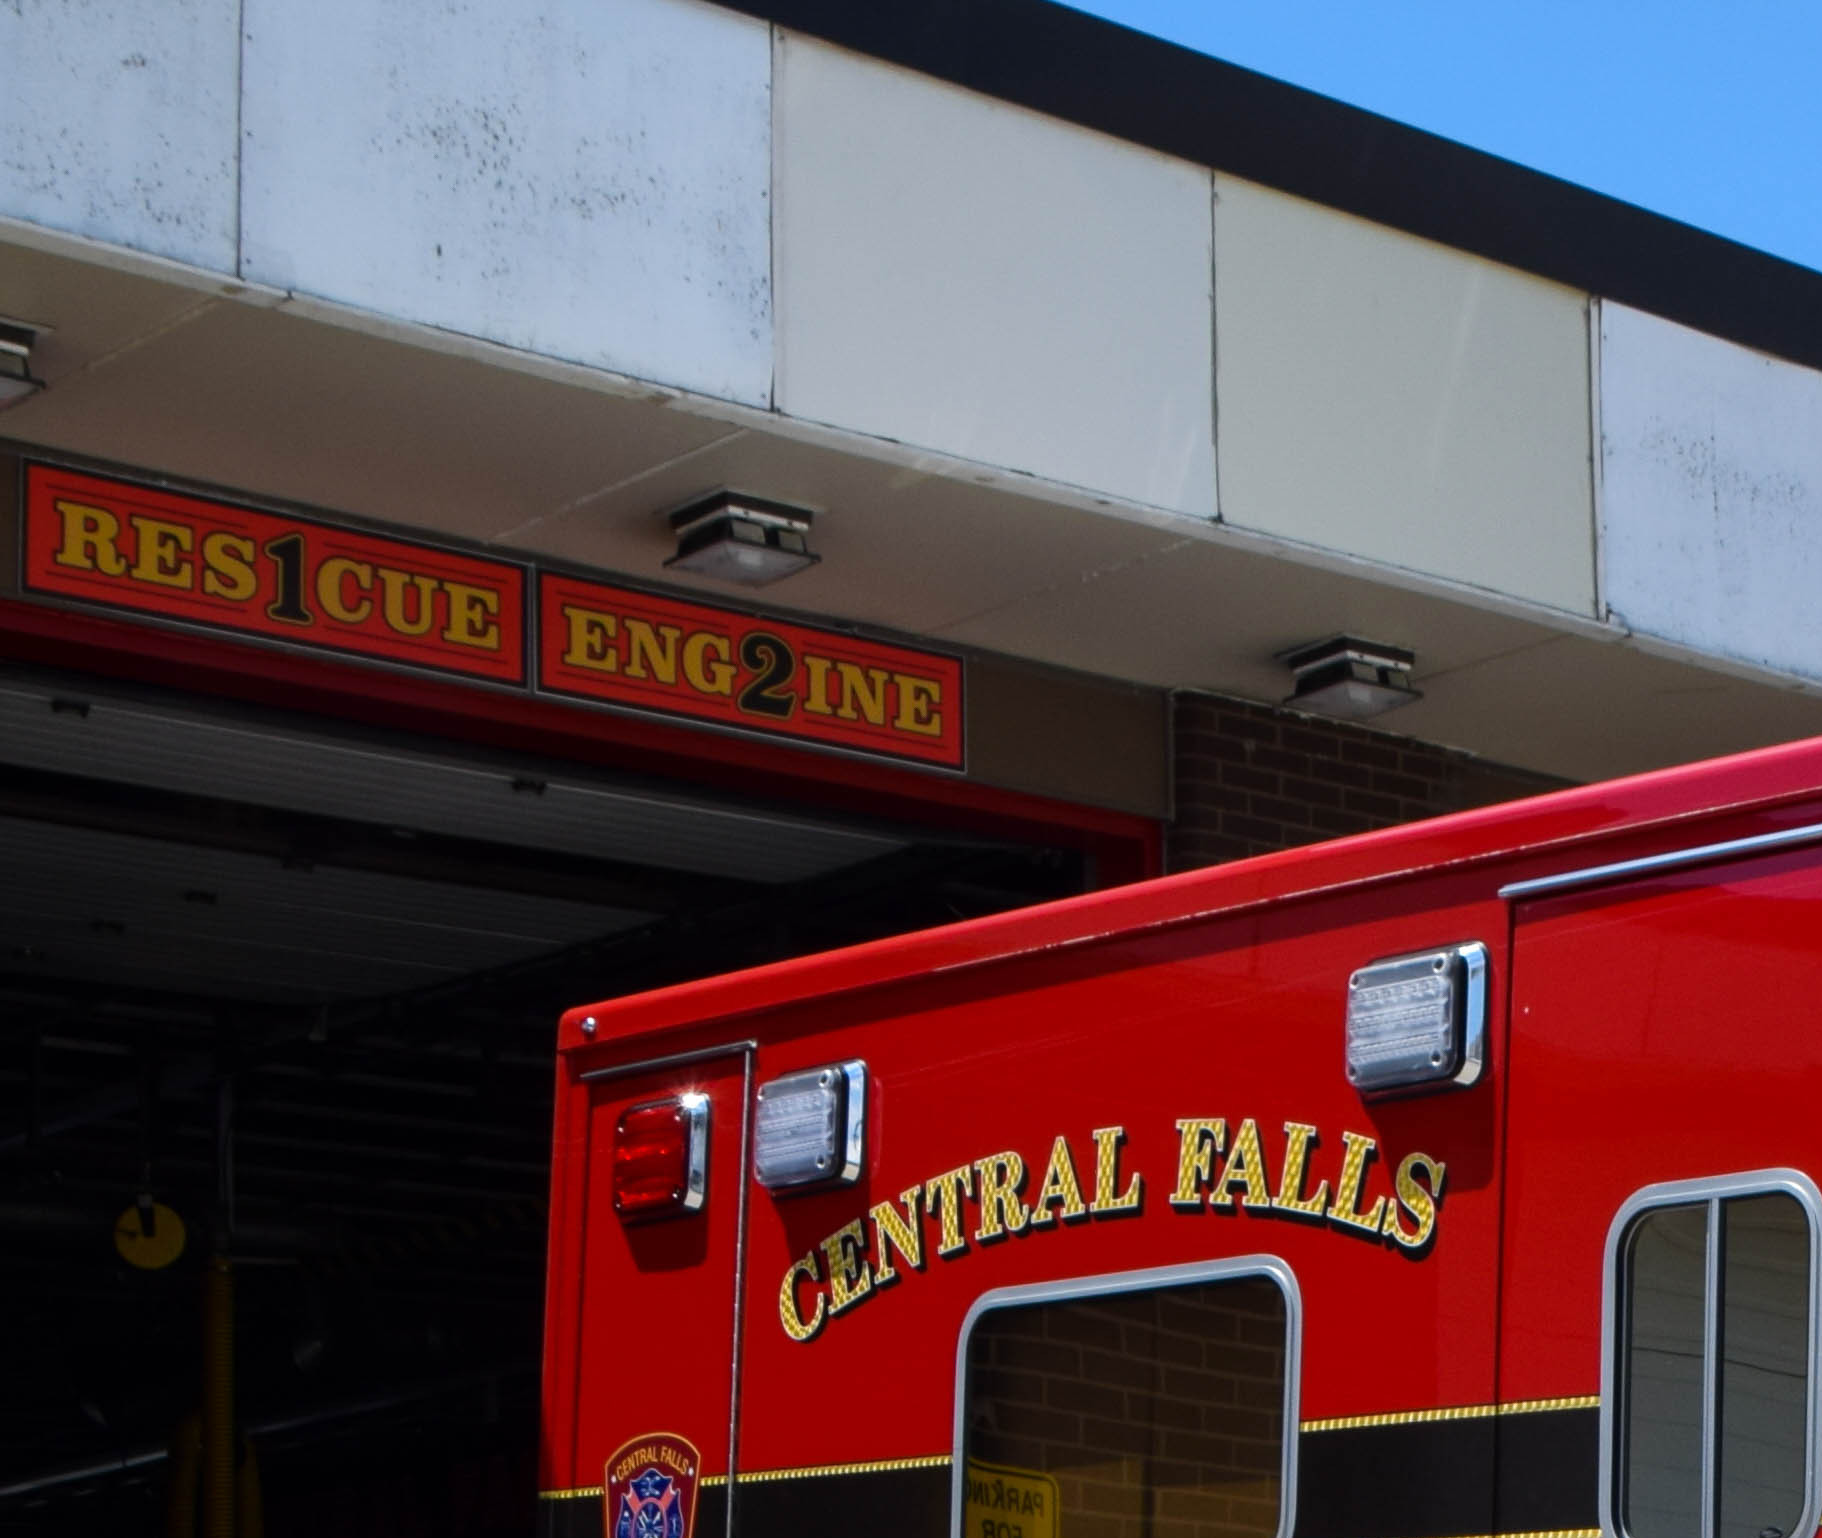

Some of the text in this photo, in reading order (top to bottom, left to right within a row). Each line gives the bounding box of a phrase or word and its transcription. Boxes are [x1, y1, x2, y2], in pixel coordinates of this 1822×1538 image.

[54, 499, 500, 652] RES1CUE
[563, 604, 943, 738] ENG2INE
[778, 1118, 1447, 1341] CENTRAL FALLS
[616, 1446, 690, 1481] CENTRAL FALLS
